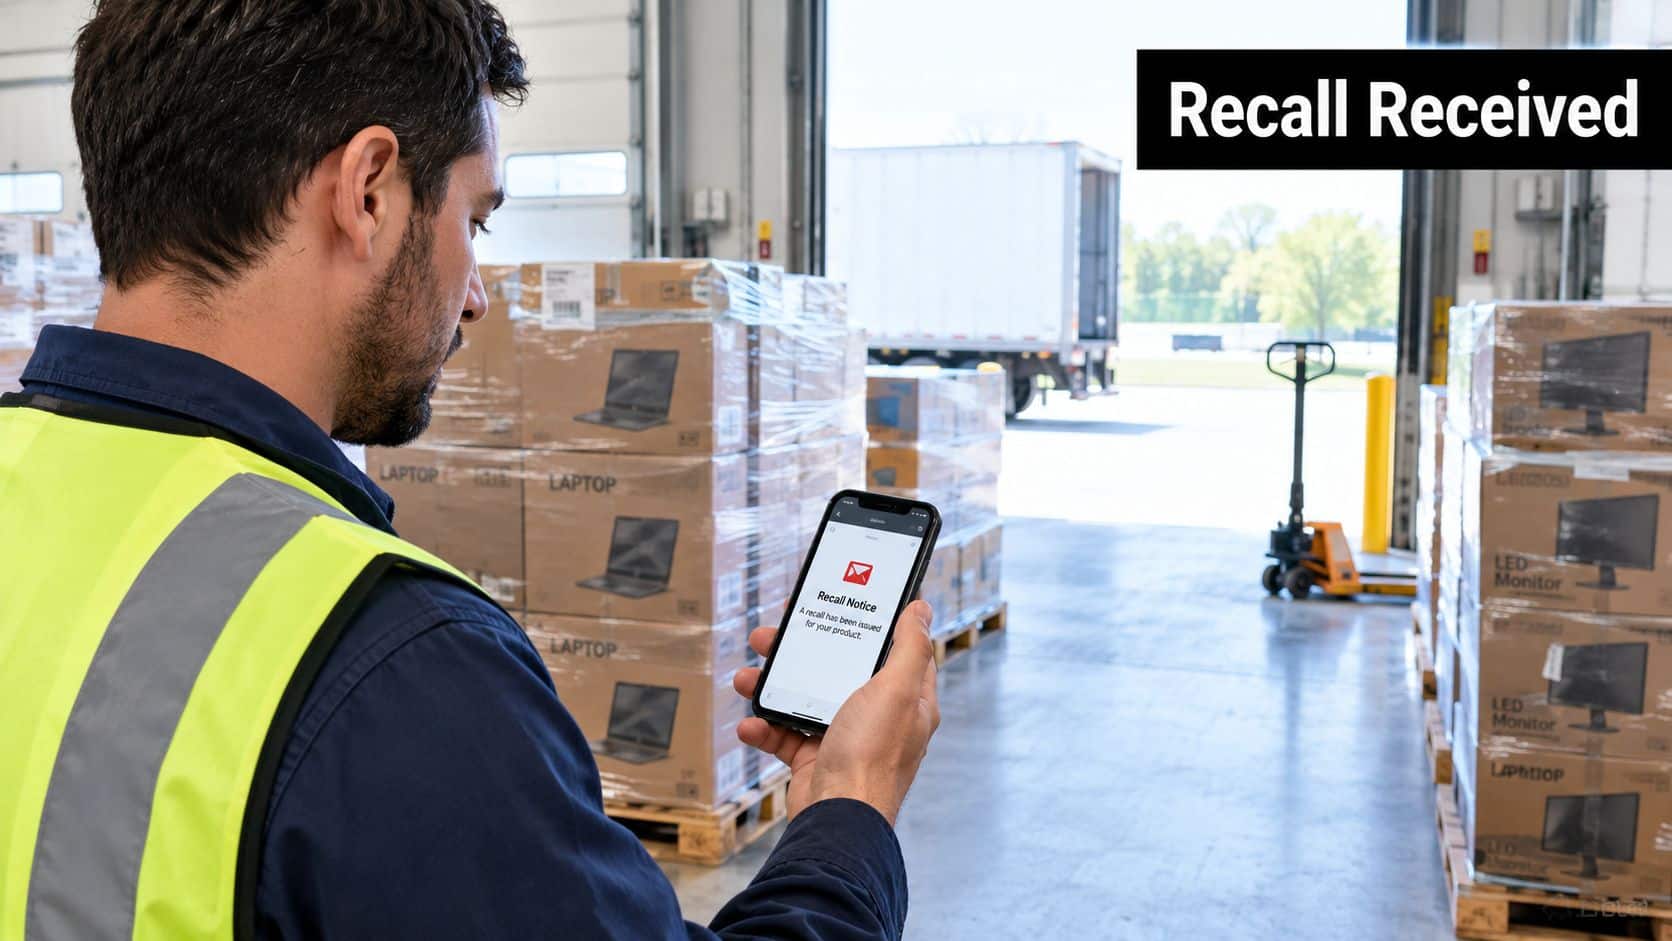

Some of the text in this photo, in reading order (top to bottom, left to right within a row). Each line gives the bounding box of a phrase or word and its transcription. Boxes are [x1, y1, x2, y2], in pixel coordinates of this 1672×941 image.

[379, 465, 439, 483] LAPTOP
[549, 475, 617, 493] LAPTOP
[1494, 555, 1529, 571] LED
[1494, 574, 1562, 591] Monitor
[817, 590, 878, 613] Recall Notice
[805, 609, 826, 619] recall
[825, 612, 839, 622] has
[839, 616, 858, 627] been
[858, 622, 882, 633] issued
[805, 619, 862, 640] for your product.
[551, 638, 617, 658] LAPTOP
[1492, 698, 1523, 713] LED
[1493, 714, 1556, 731] Monitor
